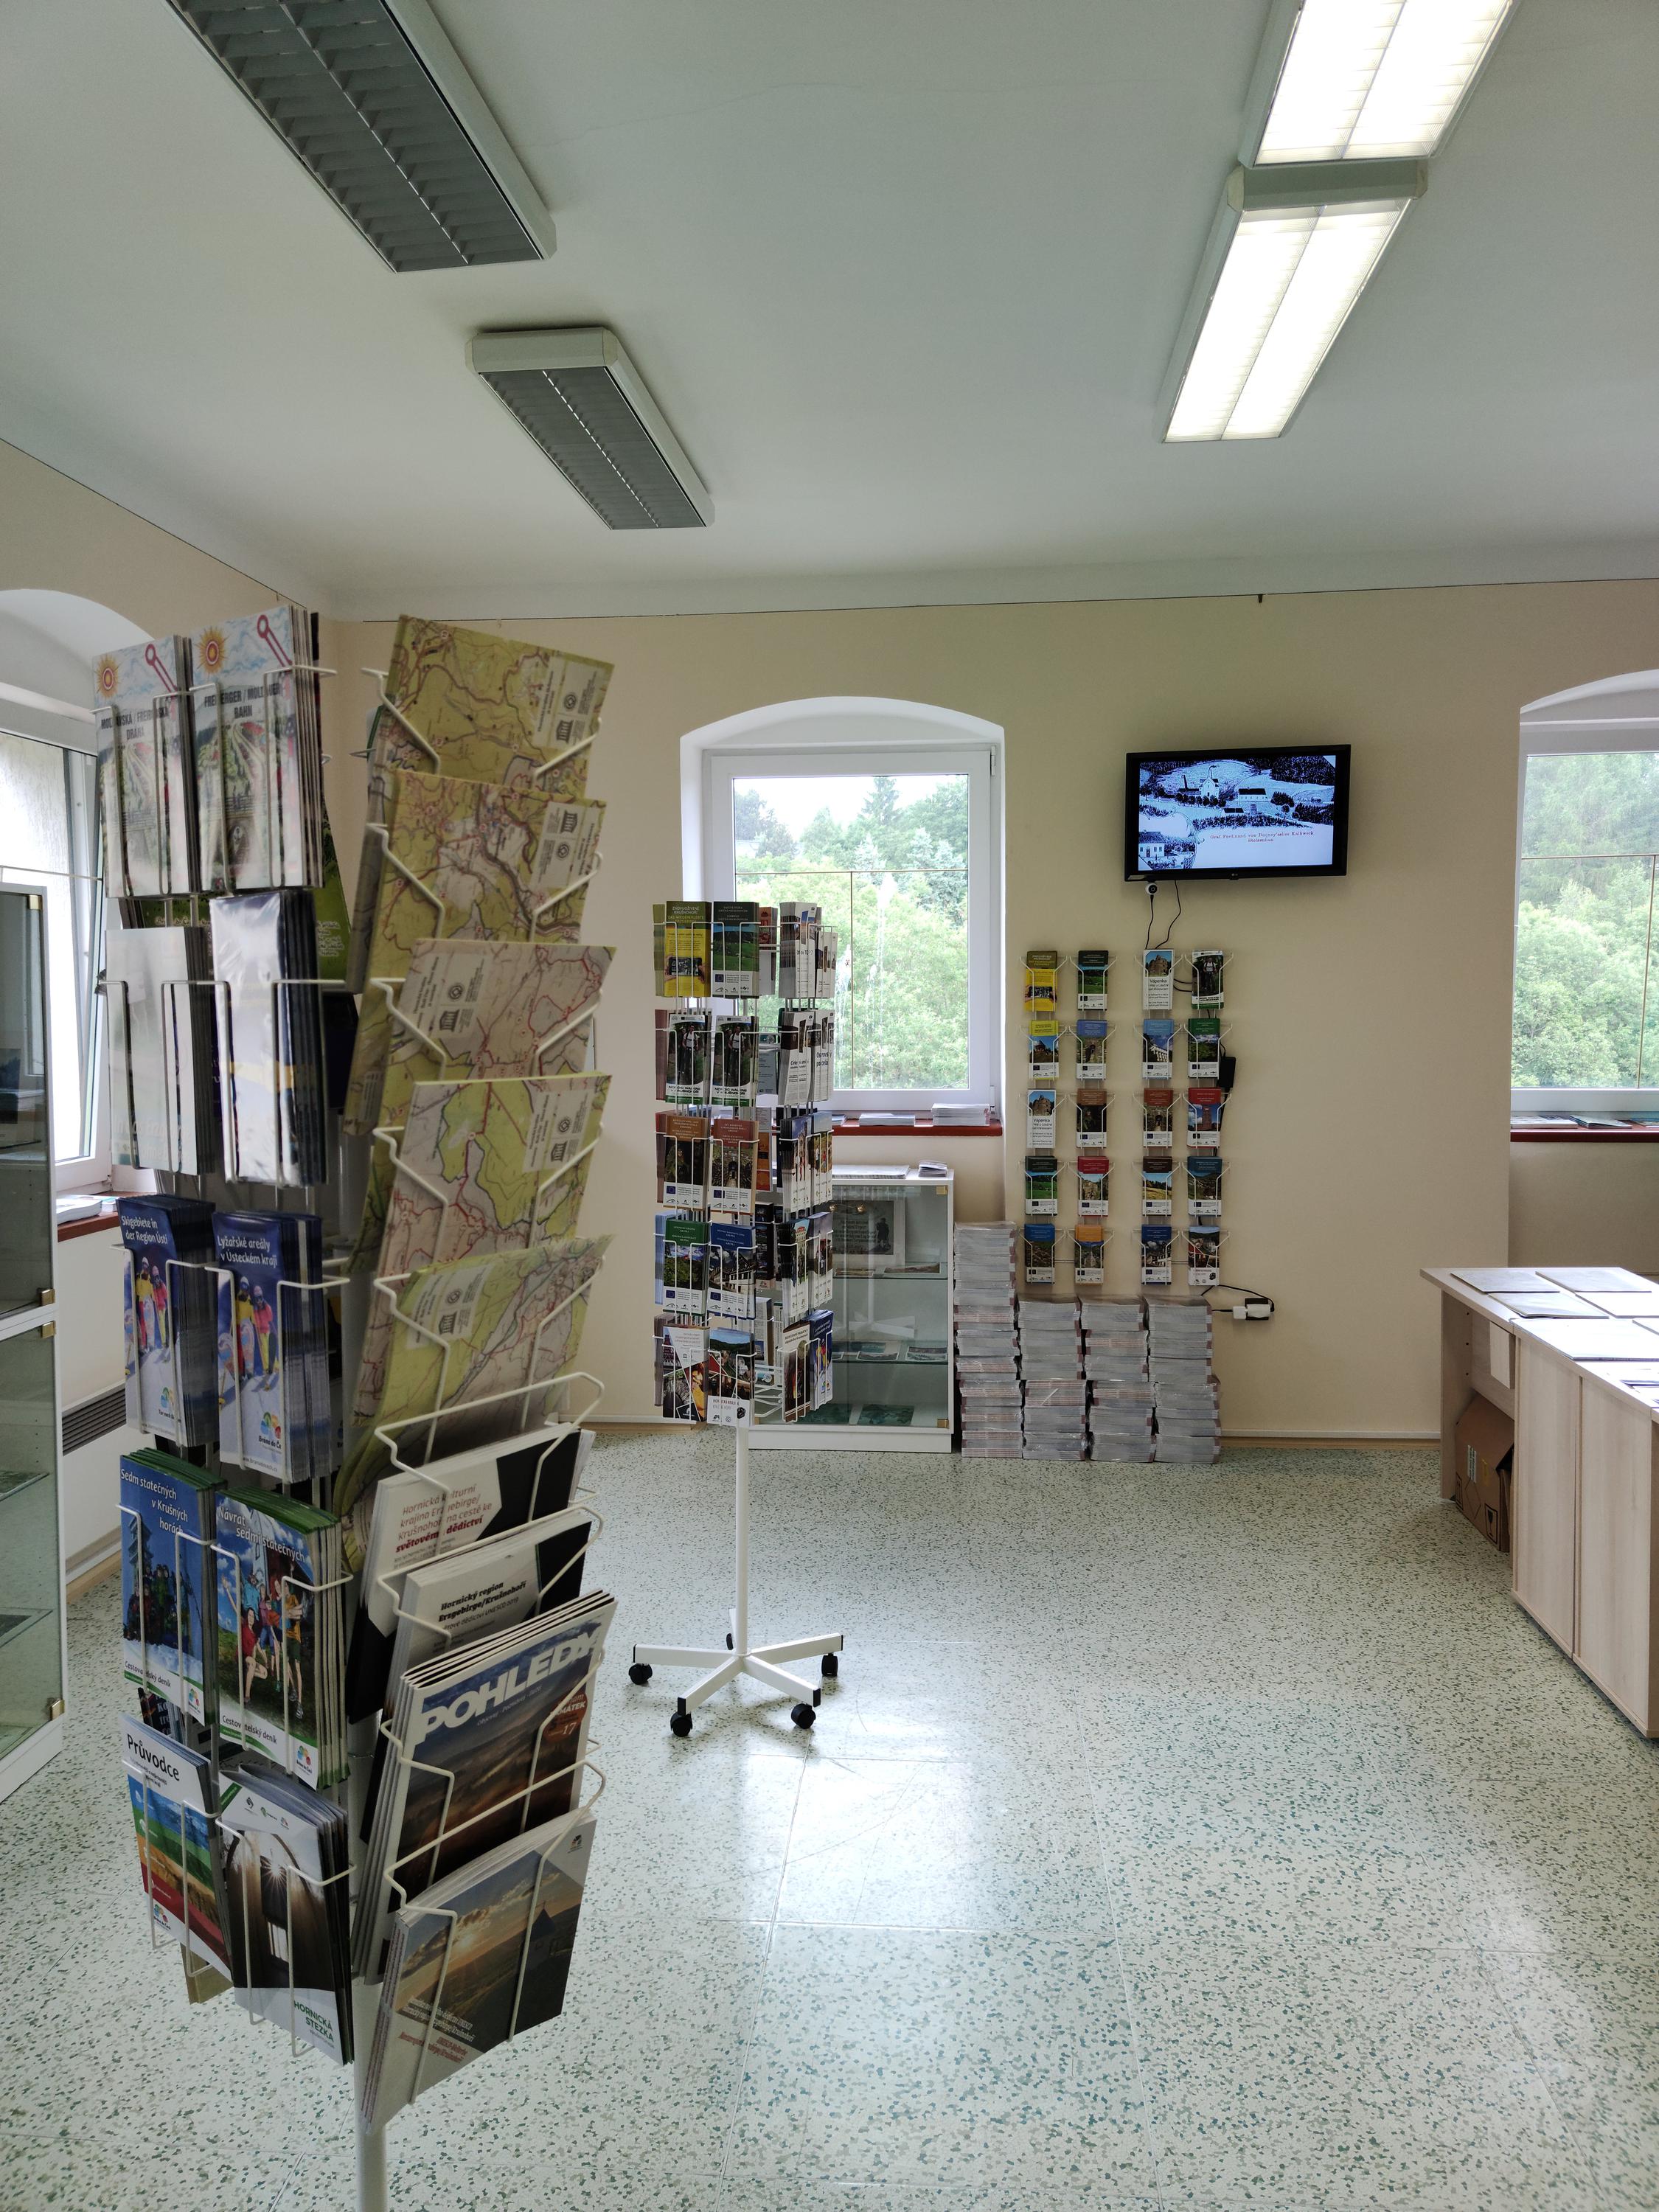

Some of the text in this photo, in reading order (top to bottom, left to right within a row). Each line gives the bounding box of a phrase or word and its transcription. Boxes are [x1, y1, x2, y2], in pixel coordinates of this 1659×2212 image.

[204, 691, 242, 708] FREIERGER
[248, 683, 283, 700] MOLDUER
[101, 715, 133, 730] MOLAVSKÁ
[234, 705, 252, 719] BAHN
[816, 1050, 832, 1058] Osrovsý
[121, 1215, 158, 1229] Skigebiete in
[125, 1231, 136, 1240] der
[136, 1231, 156, 1245] Region
[218, 1236, 271, 1252] Lyžařské areály
[220, 1249, 278, 1269] v Ústeckém kraji
[120, 1469, 177, 1500] Sedm statečných
[151, 1499, 188, 1523] v Krušných
[400, 1494, 481, 1528] krajina Erzebirge/
[403, 1483, 477, 1516] Hornická klturní
[159, 1517, 184, 1534] horách
[219, 1505, 246, 1526] Návrat
[398, 1503, 492, 1540] Krušnohoř na cestě ke
[236, 1526, 305, 1563] sedmi statečných
[396, 1514, 484, 1553] světovém dědictví
[438, 1580, 527, 1622] Erzgebirge/Krušnohoří
[441, 1582, 504, 1611] Hornický region
[125, 1660, 171, 1688] Cestovaelský deník
[417, 1628, 601, 1742] POHLEDY
[553, 1700, 586, 1717] MÁTEK
[222, 1715, 277, 1745] Cestovtelský deník
[563, 1722, 577, 1736] 17
[127, 1733, 180, 1781] Průvodce
[293, 2000, 333, 2031] HORNICKÁ
[305, 2017, 335, 2042] STEZKA
